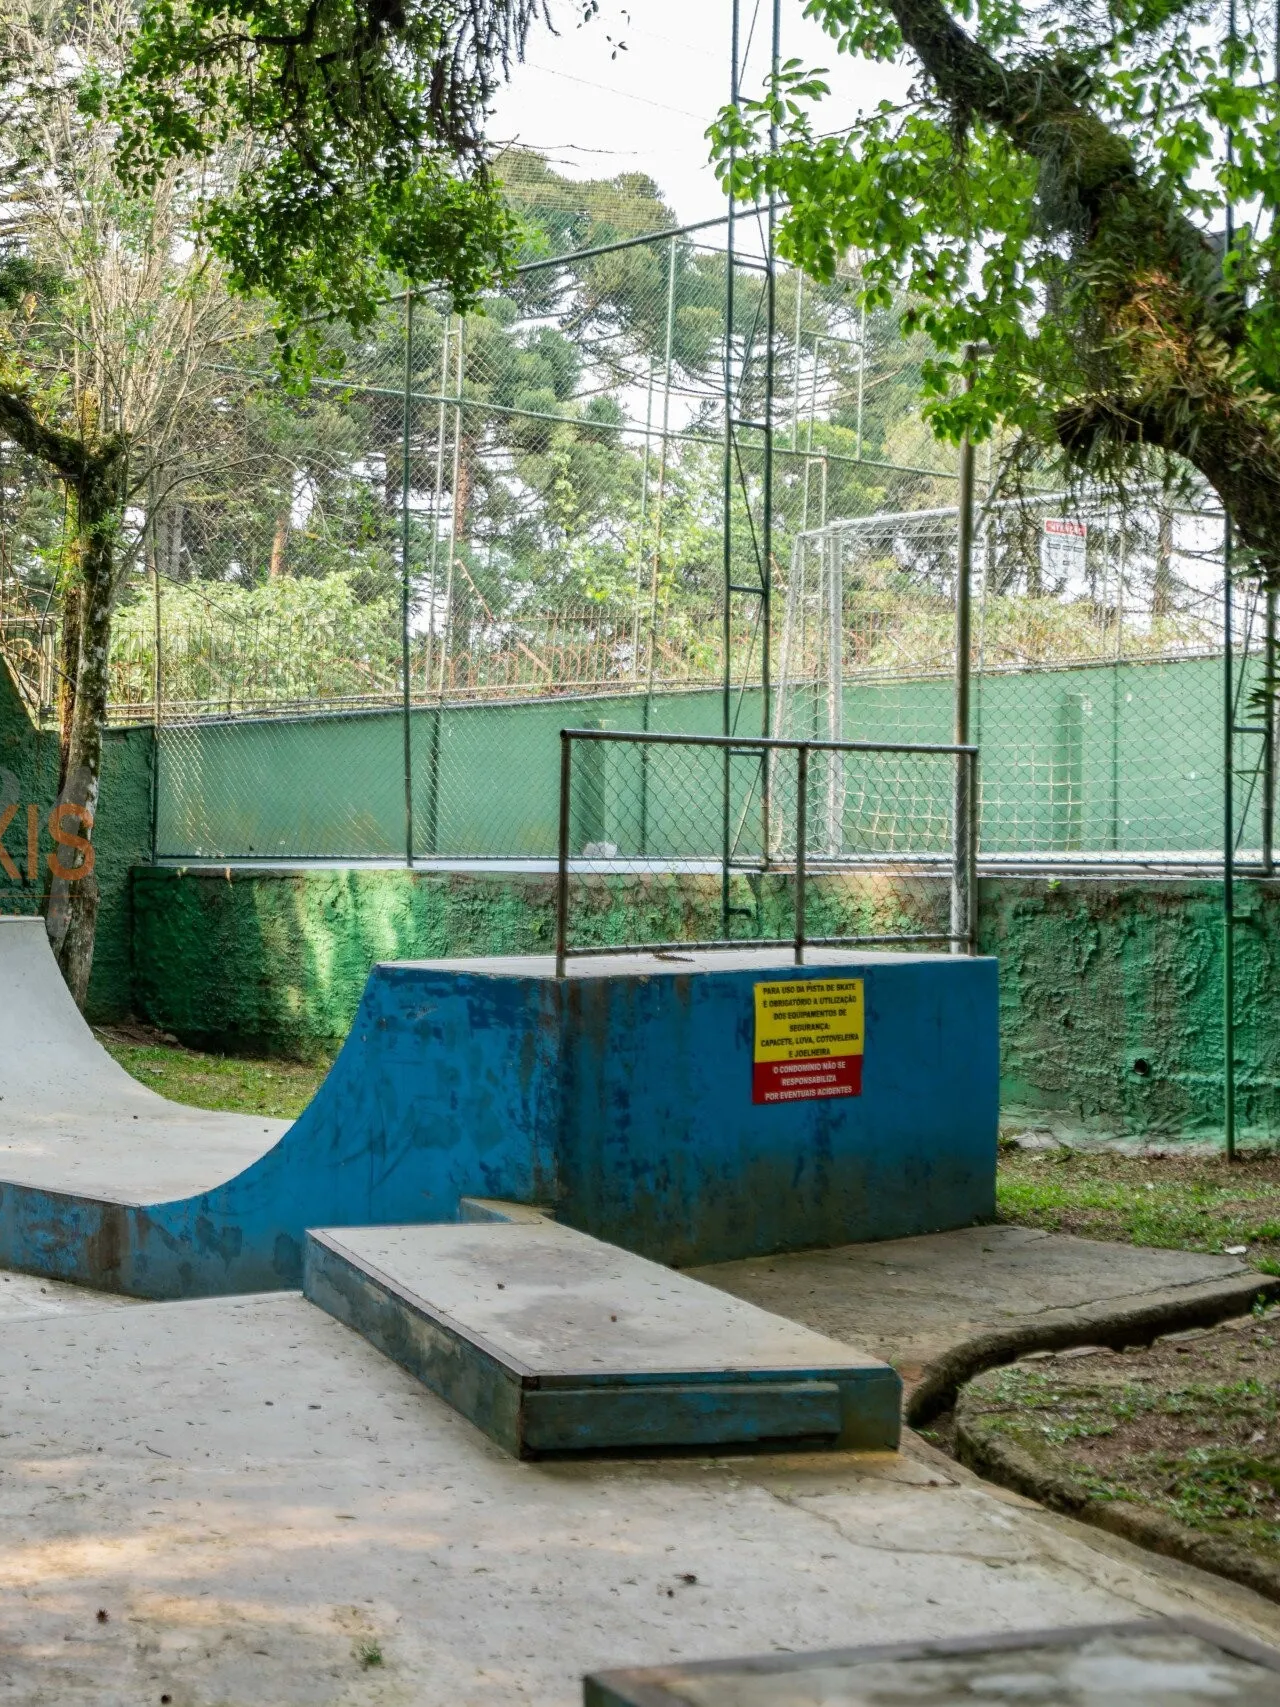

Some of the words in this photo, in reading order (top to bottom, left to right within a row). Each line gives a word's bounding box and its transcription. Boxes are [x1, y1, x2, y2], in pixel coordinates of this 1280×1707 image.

[837, 983, 856, 991] SKATE
[819, 995, 856, 1004] UTILIZAÇÃO
[774, 1012, 786, 1020] DOS
[788, 1010, 836, 1019] EQUIPAMENTOS
[789, 1023, 830, 1032] SEGURANÇA:
[760, 1038, 794, 1047] CAPACETE,
[816, 1034, 859, 1043] COTOVELEIRA
[794, 1048, 830, 1057] JOELHEIRA
[773, 1066, 779, 1074] O
[779, 1063, 821, 1073] CONDOMÍNIO
[822, 1061, 836, 1070] NÃO
[781, 1075, 836, 1086] RESPONSABILIZA
[765, 1092, 779, 1101] POR
[780, 1089, 816, 1099] EVENTUAIS
[817, 1086, 852, 1095] ACIDENTES
